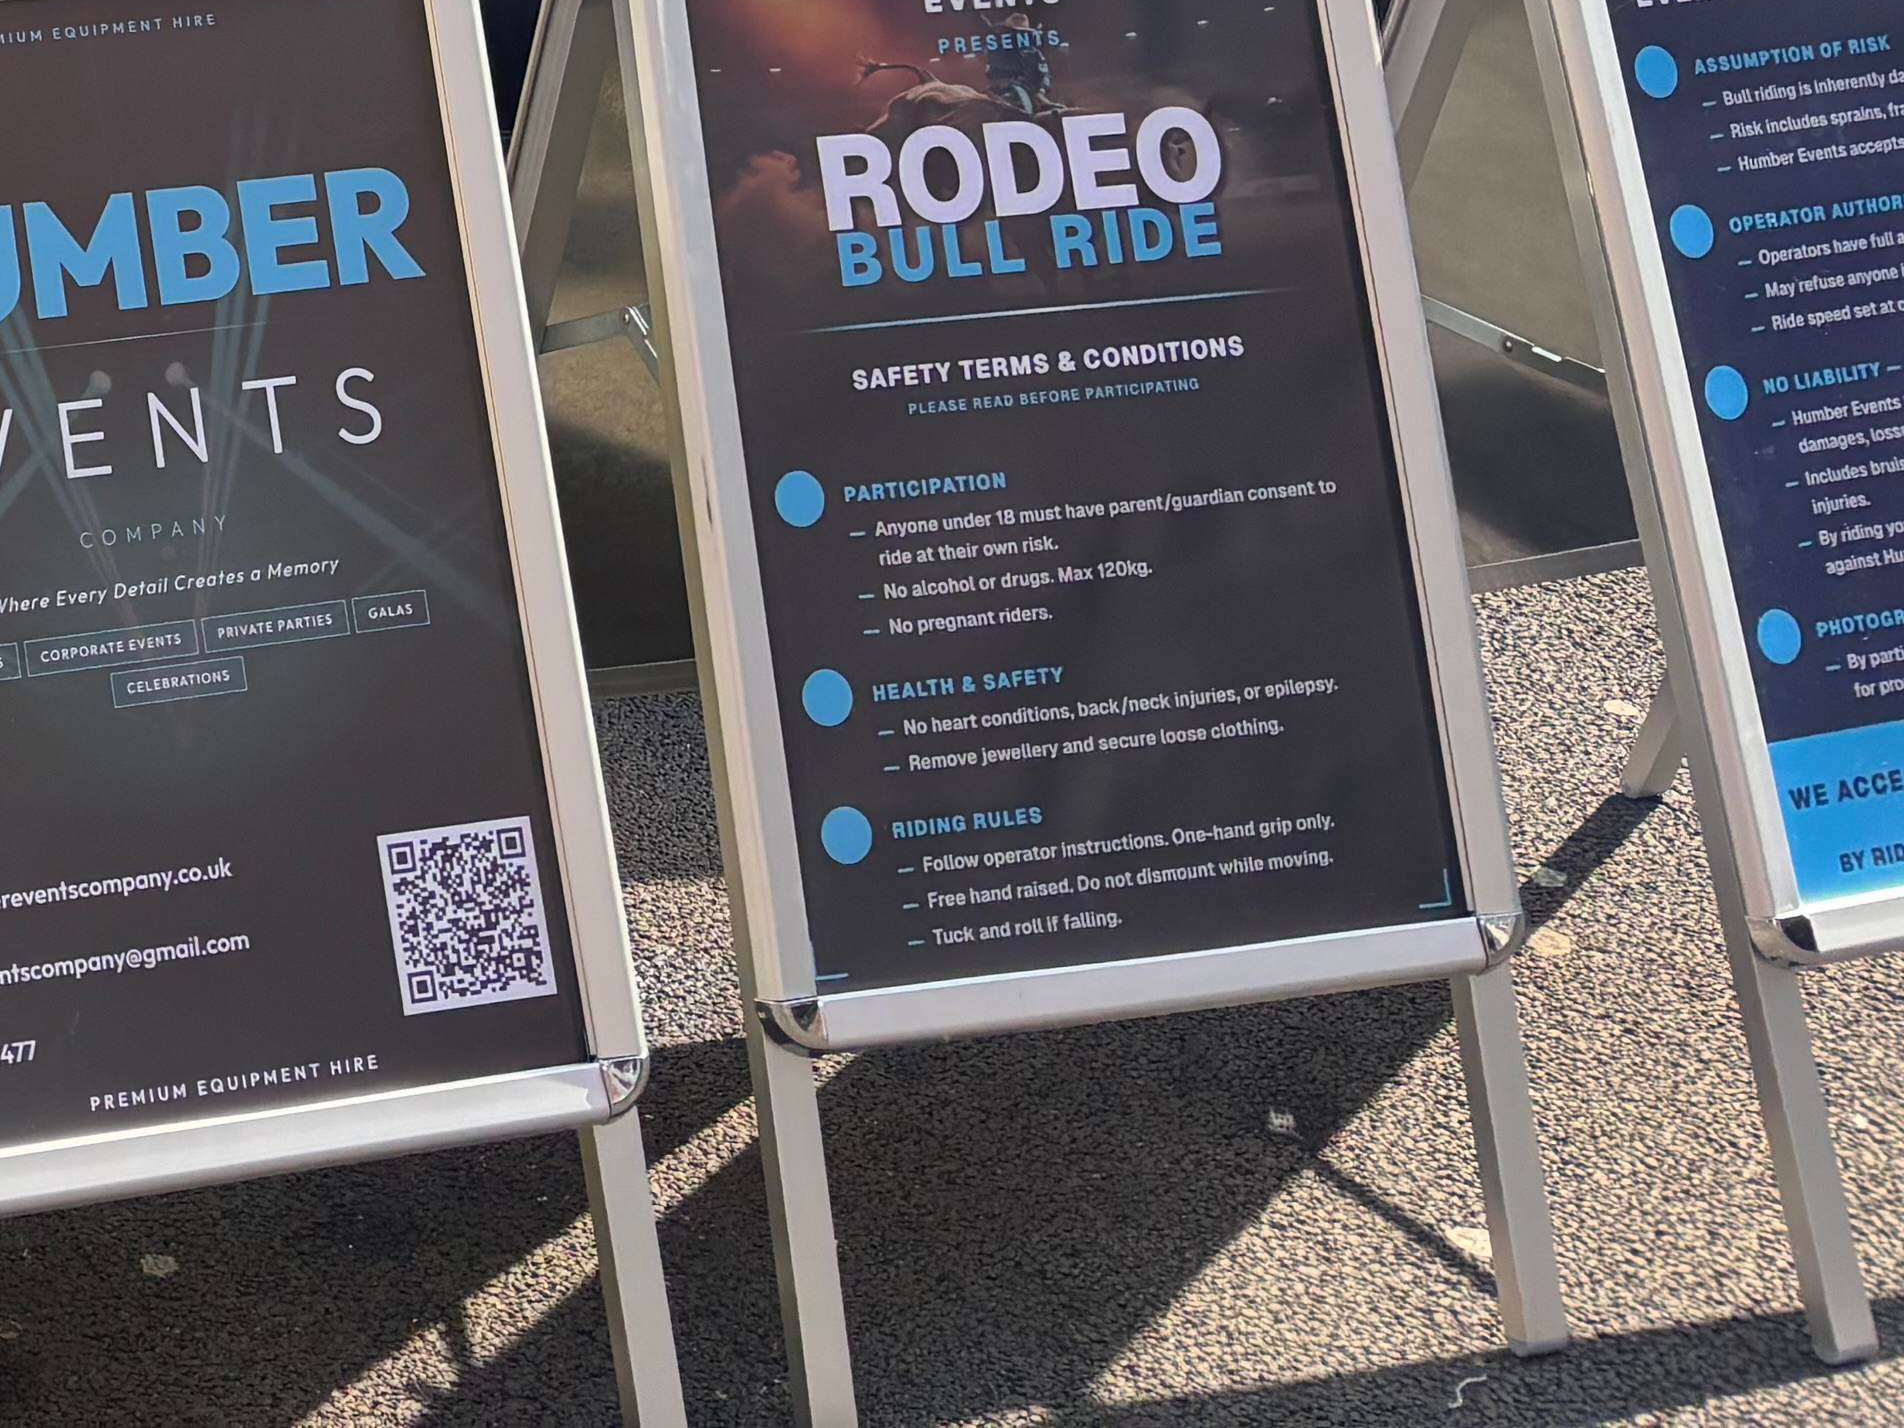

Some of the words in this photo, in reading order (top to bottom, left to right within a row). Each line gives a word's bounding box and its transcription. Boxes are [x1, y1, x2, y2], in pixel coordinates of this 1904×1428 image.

[52, 18, 162, 40] EQUIPMENT
[172, 13, 215, 29] HIRE
[938, 30, 1060, 55] PRESENTS
[1695, 45, 1815, 75] ASSUMPTION
[1819, 40, 1842, 59] OF
[1847, 34, 1891, 55] RISK
[1722, 87, 1753, 106] Bull
[1753, 84, 1797, 102] riding
[1798, 81, 1813, 96] is
[1813, 71, 1886, 95] inherently
[1729, 120, 1764, 139] Risk
[1764, 113, 1829, 134] includes
[1829, 105, 1887, 127] sprains,
[816, 106, 1221, 231] RODEO
[1737, 151, 1795, 172] Humber
[1796, 144, 1848, 163] Events
[1728, 205, 1826, 233] OPERATOR
[1832, 194, 1904, 219] AUTHOR
[837, 220, 1025, 287] BULL
[1050, 202, 1222, 269] RIDE
[1758, 243, 1832, 266] Operators
[1832, 238, 1868, 254] have
[1869, 231, 1896, 249] full
[852, 361, 951, 390] SAFETY
[957, 353, 1050, 381] TERMS
[1058, 350, 1076, 372] &
[1083, 335, 1244, 370] CONDITIONS
[1762, 376, 1789, 395] NO
[1793, 362, 1880, 390] LIABILITY
[908, 398, 968, 415] PLEASE
[972, 394, 1014, 409] READ
[1019, 388, 1081, 406] BEFORE
[1084, 377, 1200, 400] PARTICIPATING
[1791, 405, 1849, 426] Humber
[1850, 397, 1901, 417] Events
[843, 471, 1007, 503] PARTICIPATION
[1811, 493, 1871, 515] injuries.
[875, 519, 939, 538] Anyone
[942, 512, 992, 531] under
[995, 508, 1016, 526] 18
[1019, 505, 1063, 524] must
[1065, 503, 1105, 519] have
[1108, 488, 1245, 518] parent/guardian
[1247, 481, 1316, 502] consent
[1318, 480, 1337, 494] to
[79, 514, 226, 549] COMPANY
[879, 548, 913, 566] ride
[916, 546, 935, 563] at
[937, 542, 979, 561] their
[982, 541, 1019, 557] own
[1022, 535, 1059, 553] risk.
[56, 589, 108, 607] Every
[113, 577, 168, 600] Detail
[174, 570, 245, 591] Creates
[250, 569, 261, 582] a
[267, 559, 339, 580] Memory
[883, 583, 908, 600] No
[911, 575, 977, 597] alcohol
[978, 576, 997, 591] or
[1000, 571, 1055, 589] drugs.
[1057, 566, 1094, 583] Max
[1097, 559, 1153, 579] 120kg.
[217, 620, 274, 639] PRIVATE
[277, 613, 333, 632] PARTIES
[368, 603, 413, 620] GALAS
[888, 617, 914, 635] No
[917, 611, 996, 636] pregnant
[998, 607, 1053, 624] riders.
[40, 640, 125, 663] CORPORATE
[128, 633, 182, 651] EVENTS
[126, 669, 230, 694] CELEBRATIONS
[872, 677, 955, 702] HEALTH
[961, 675, 976, 693] &
[983, 666, 1063, 691] SAFETY
[903, 718, 928, 736] No
[930, 714, 979, 733] heart
[981, 706, 1075, 728] conditions,
[1076, 693, 1172, 717] back/neck
[1173, 687, 1241, 710] injuries,
[1243, 685, 1261, 700] or
[1264, 678, 1339, 700] epilepsy.
[908, 751, 978, 772] Remove
[981, 742, 1059, 767] jewellery
[1062, 735, 1095, 754] and
[1097, 732, 1157, 751] secure
[1159, 727, 1207, 745] loose
[1210, 717, 1284, 739] clothing.
[1788, 783, 1830, 811] WE
[892, 815, 967, 839] RIDING
[972, 806, 1043, 830] RULES
[922, 853, 979, 873] Follow
[983, 845, 1058, 868] operator
[1061, 833, 1170, 859] instructions.
[1171, 820, 1256, 845] One-hand
[1259, 817, 1293, 839] grip
[1295, 813, 1335, 831] only.
[927, 891, 966, 909] Free
[969, 883, 1013, 904] hand
[1016, 877, 1075, 899] raised.
[1076, 874, 1101, 892] Do
[1104, 871, 1134, 889] not
[1136, 861, 1217, 885] dismount
[1218, 856, 1264, 876] while
[1267, 850, 1334, 870] moving.
[931, 925, 975, 945] Tuck
[978, 921, 1012, 940] and
[1014, 917, 1045, 936] roll
[1046, 915, 1059, 933] if
[1062, 911, 1123, 931] falling.
[89, 1083, 187, 1112] PREMIUM
[196, 1062, 320, 1097] EQUIPMENT
[329, 1054, 379, 1076] HIRE
